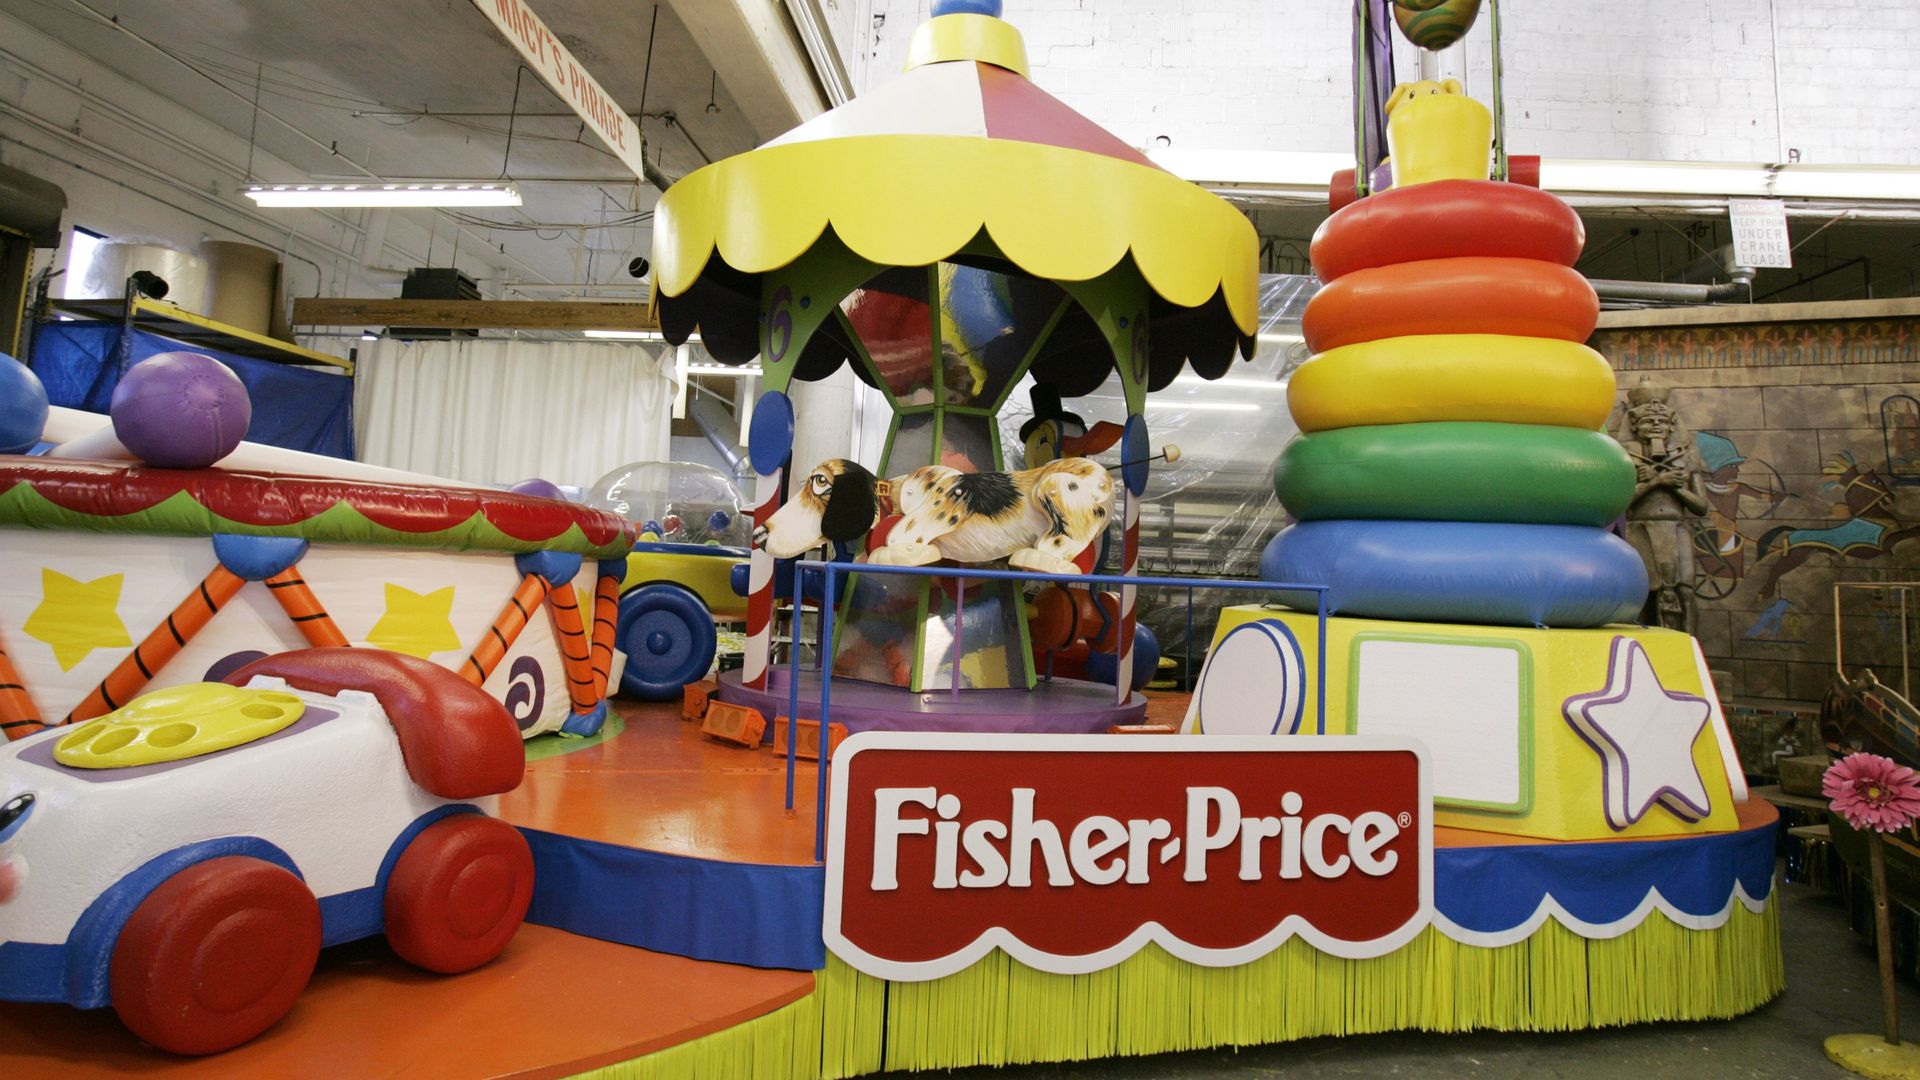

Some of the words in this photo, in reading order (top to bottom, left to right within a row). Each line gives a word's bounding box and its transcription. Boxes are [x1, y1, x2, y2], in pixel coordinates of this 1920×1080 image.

[568, 61, 626, 152] PARADE
[1734, 217, 1756, 227] KEEP
[1739, 228, 1783, 240] UNDER
[1740, 241, 1784, 252] CRANE
[1742, 254, 1785, 266] LOADS
